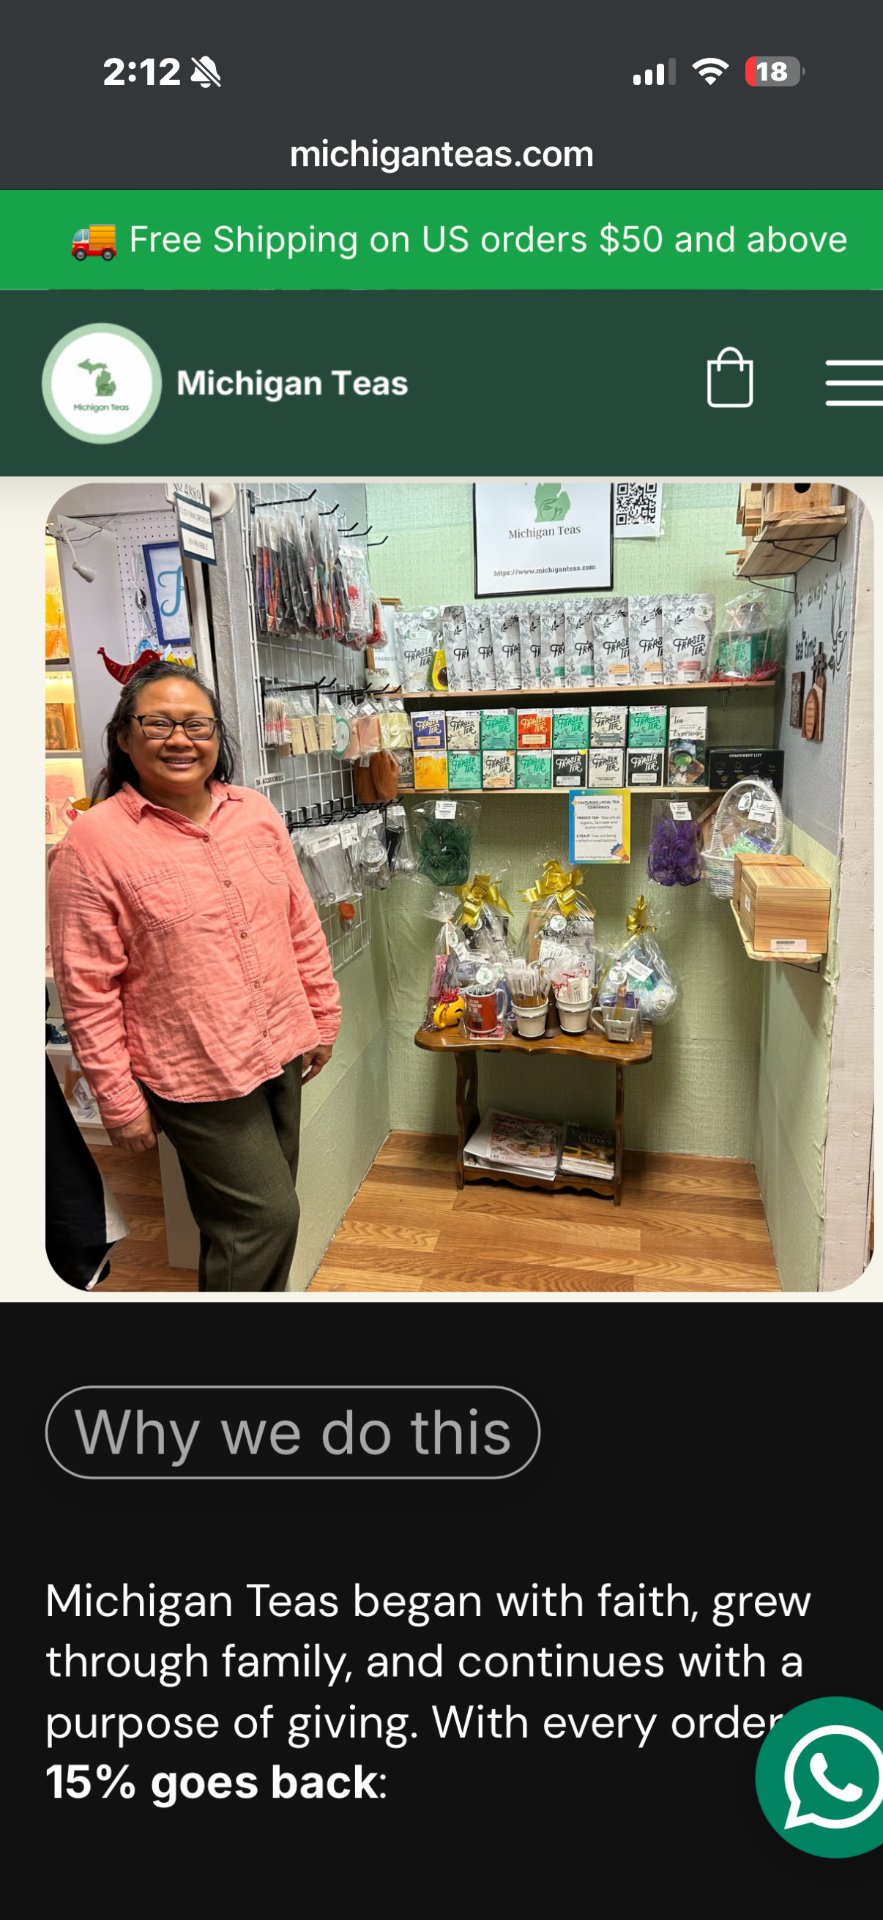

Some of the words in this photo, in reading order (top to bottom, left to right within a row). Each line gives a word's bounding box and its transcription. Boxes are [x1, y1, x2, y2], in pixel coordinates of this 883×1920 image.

[104, 58, 180, 85] 2:12
[756, 61, 788, 82] 18
[291, 139, 594, 173] michiganteas.com
[131, 226, 201, 252] Free
[214, 225, 357, 260] Shipping
[370, 232, 409, 252] on
[424, 225, 468, 253] US
[482, 226, 587, 252] orders
[600, 222, 662, 256] $50
[675, 226, 734, 253] and
[747, 226, 847, 253] above
[178, 369, 322, 402] Michigan
[331, 370, 408, 395] Teas
[74, 404, 109, 413] Michigan
[509, 528, 555, 539] Michigan
[558, 525, 581, 536] Teas
[494, 565, 596, 577] https://www.michiganteas.com
[673, 634, 706, 652] FRASER
[692, 643, 707, 657] TEA
[75, 1410, 200, 1466] Why
[221, 1421, 300, 1455] we
[323, 1410, 390, 1455] do
[411, 1408, 511, 1455] this
[48, 1583, 231, 1627] Michigan
[246, 1584, 338, 1617] Teas
[355, 1583, 480, 1627] began
[496, 1583, 582, 1616] with
[598, 1583, 698, 1622] faith,
[713, 1592, 811, 1627] grew
[46, 1643, 207, 1687] through
[222, 1643, 352, 1687] family,
[367, 1643, 442, 1677] and
[459, 1643, 664, 1677] continues
[679, 1643, 765, 1677] with
[782, 1653, 802, 1677] a
[48, 1714, 219, 1748] purpose
[234, 1705, 274, 1738] of
[288, 1704, 417, 1748] giving.
[432, 1704, 527, 1738] With
[544, 1714, 657, 1748] every
[47, 1764, 135, 1799] 15%
[152, 1772, 258, 1808] goes
[273, 1764, 386, 1799] back:
